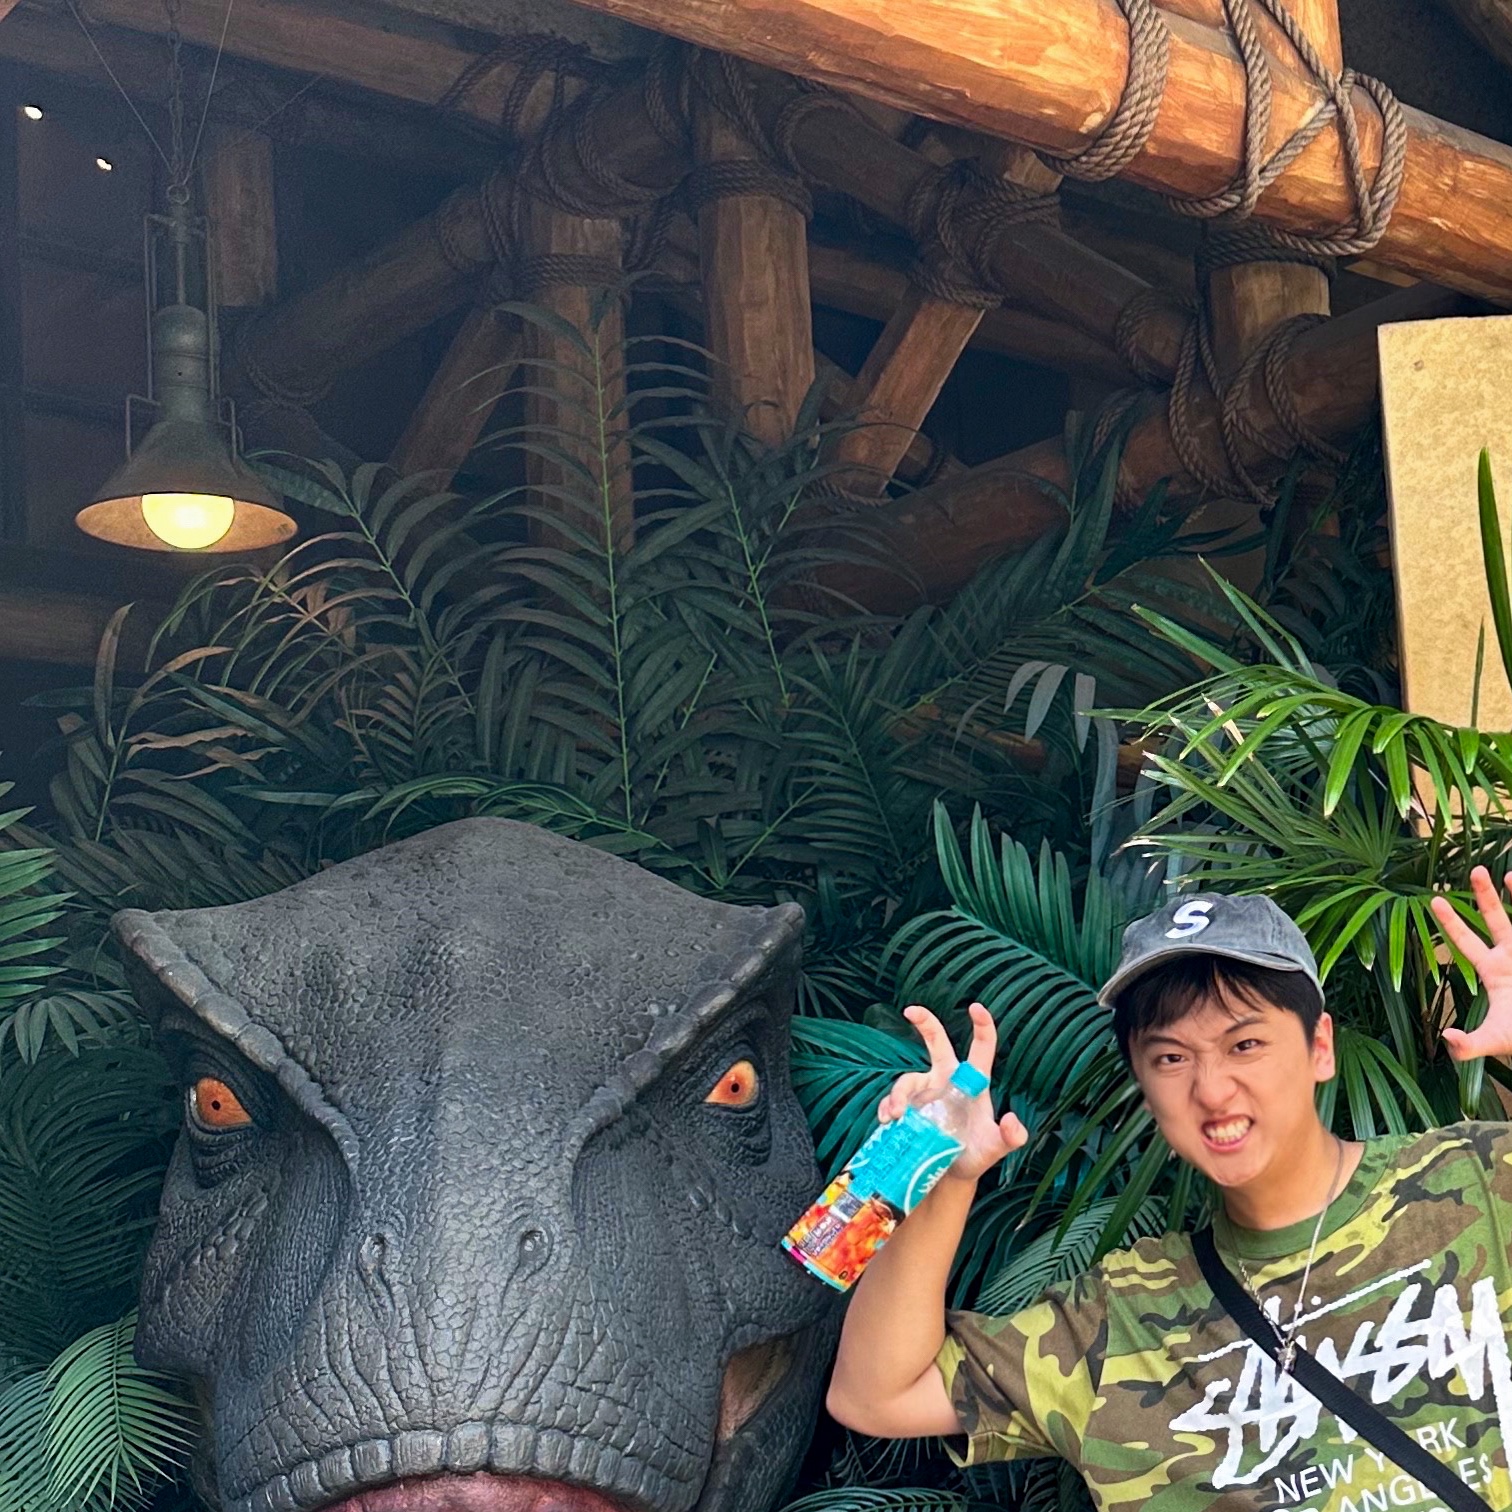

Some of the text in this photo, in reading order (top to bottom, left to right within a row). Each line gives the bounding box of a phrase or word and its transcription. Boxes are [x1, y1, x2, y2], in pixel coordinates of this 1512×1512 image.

[1164, 900, 1214, 939] S
[1274, 1417, 1466, 1504] NEW YRK
